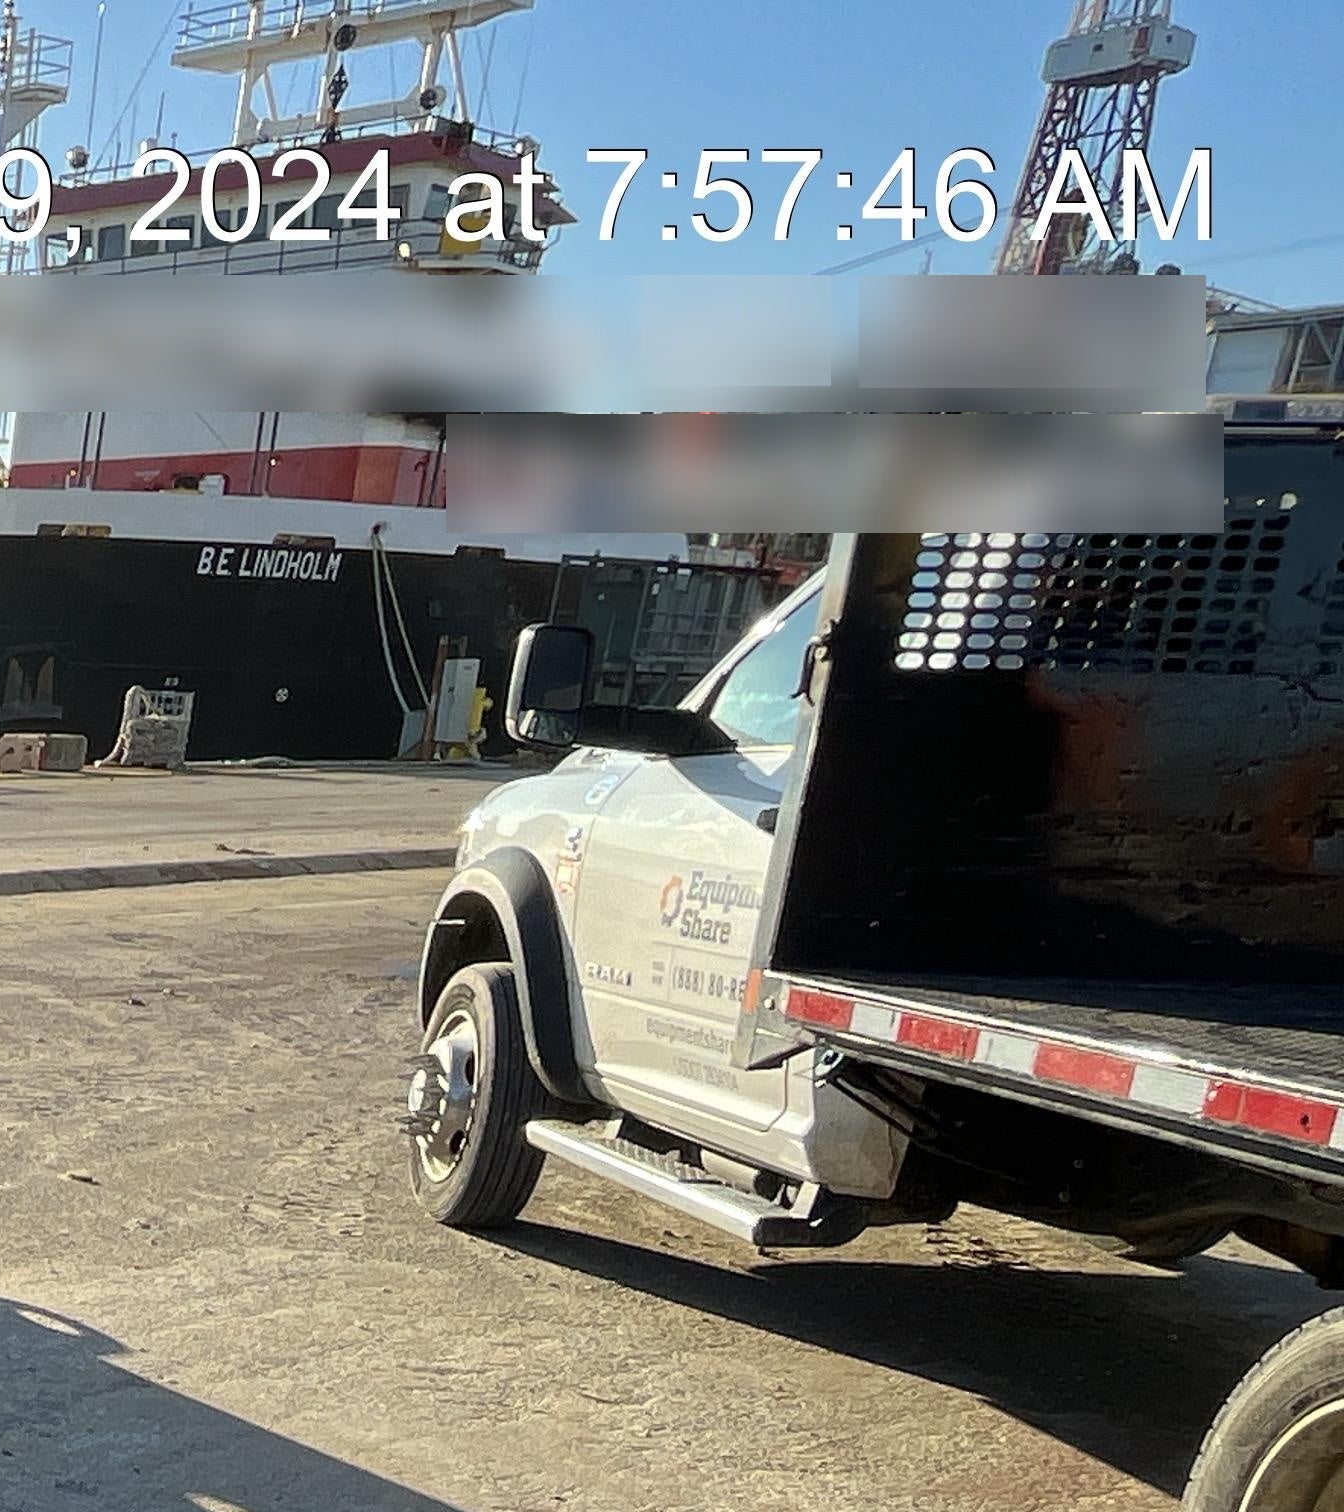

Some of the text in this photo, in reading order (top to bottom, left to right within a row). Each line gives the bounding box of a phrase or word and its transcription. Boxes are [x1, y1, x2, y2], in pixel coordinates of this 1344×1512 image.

[238, 548, 343, 583] LINDHOLM
[686, 870, 764, 914] Equipm
[679, 908, 732, 944] Share
[672, 966, 705, 995] (888)
[707, 973, 747, 1002] 80-RE
